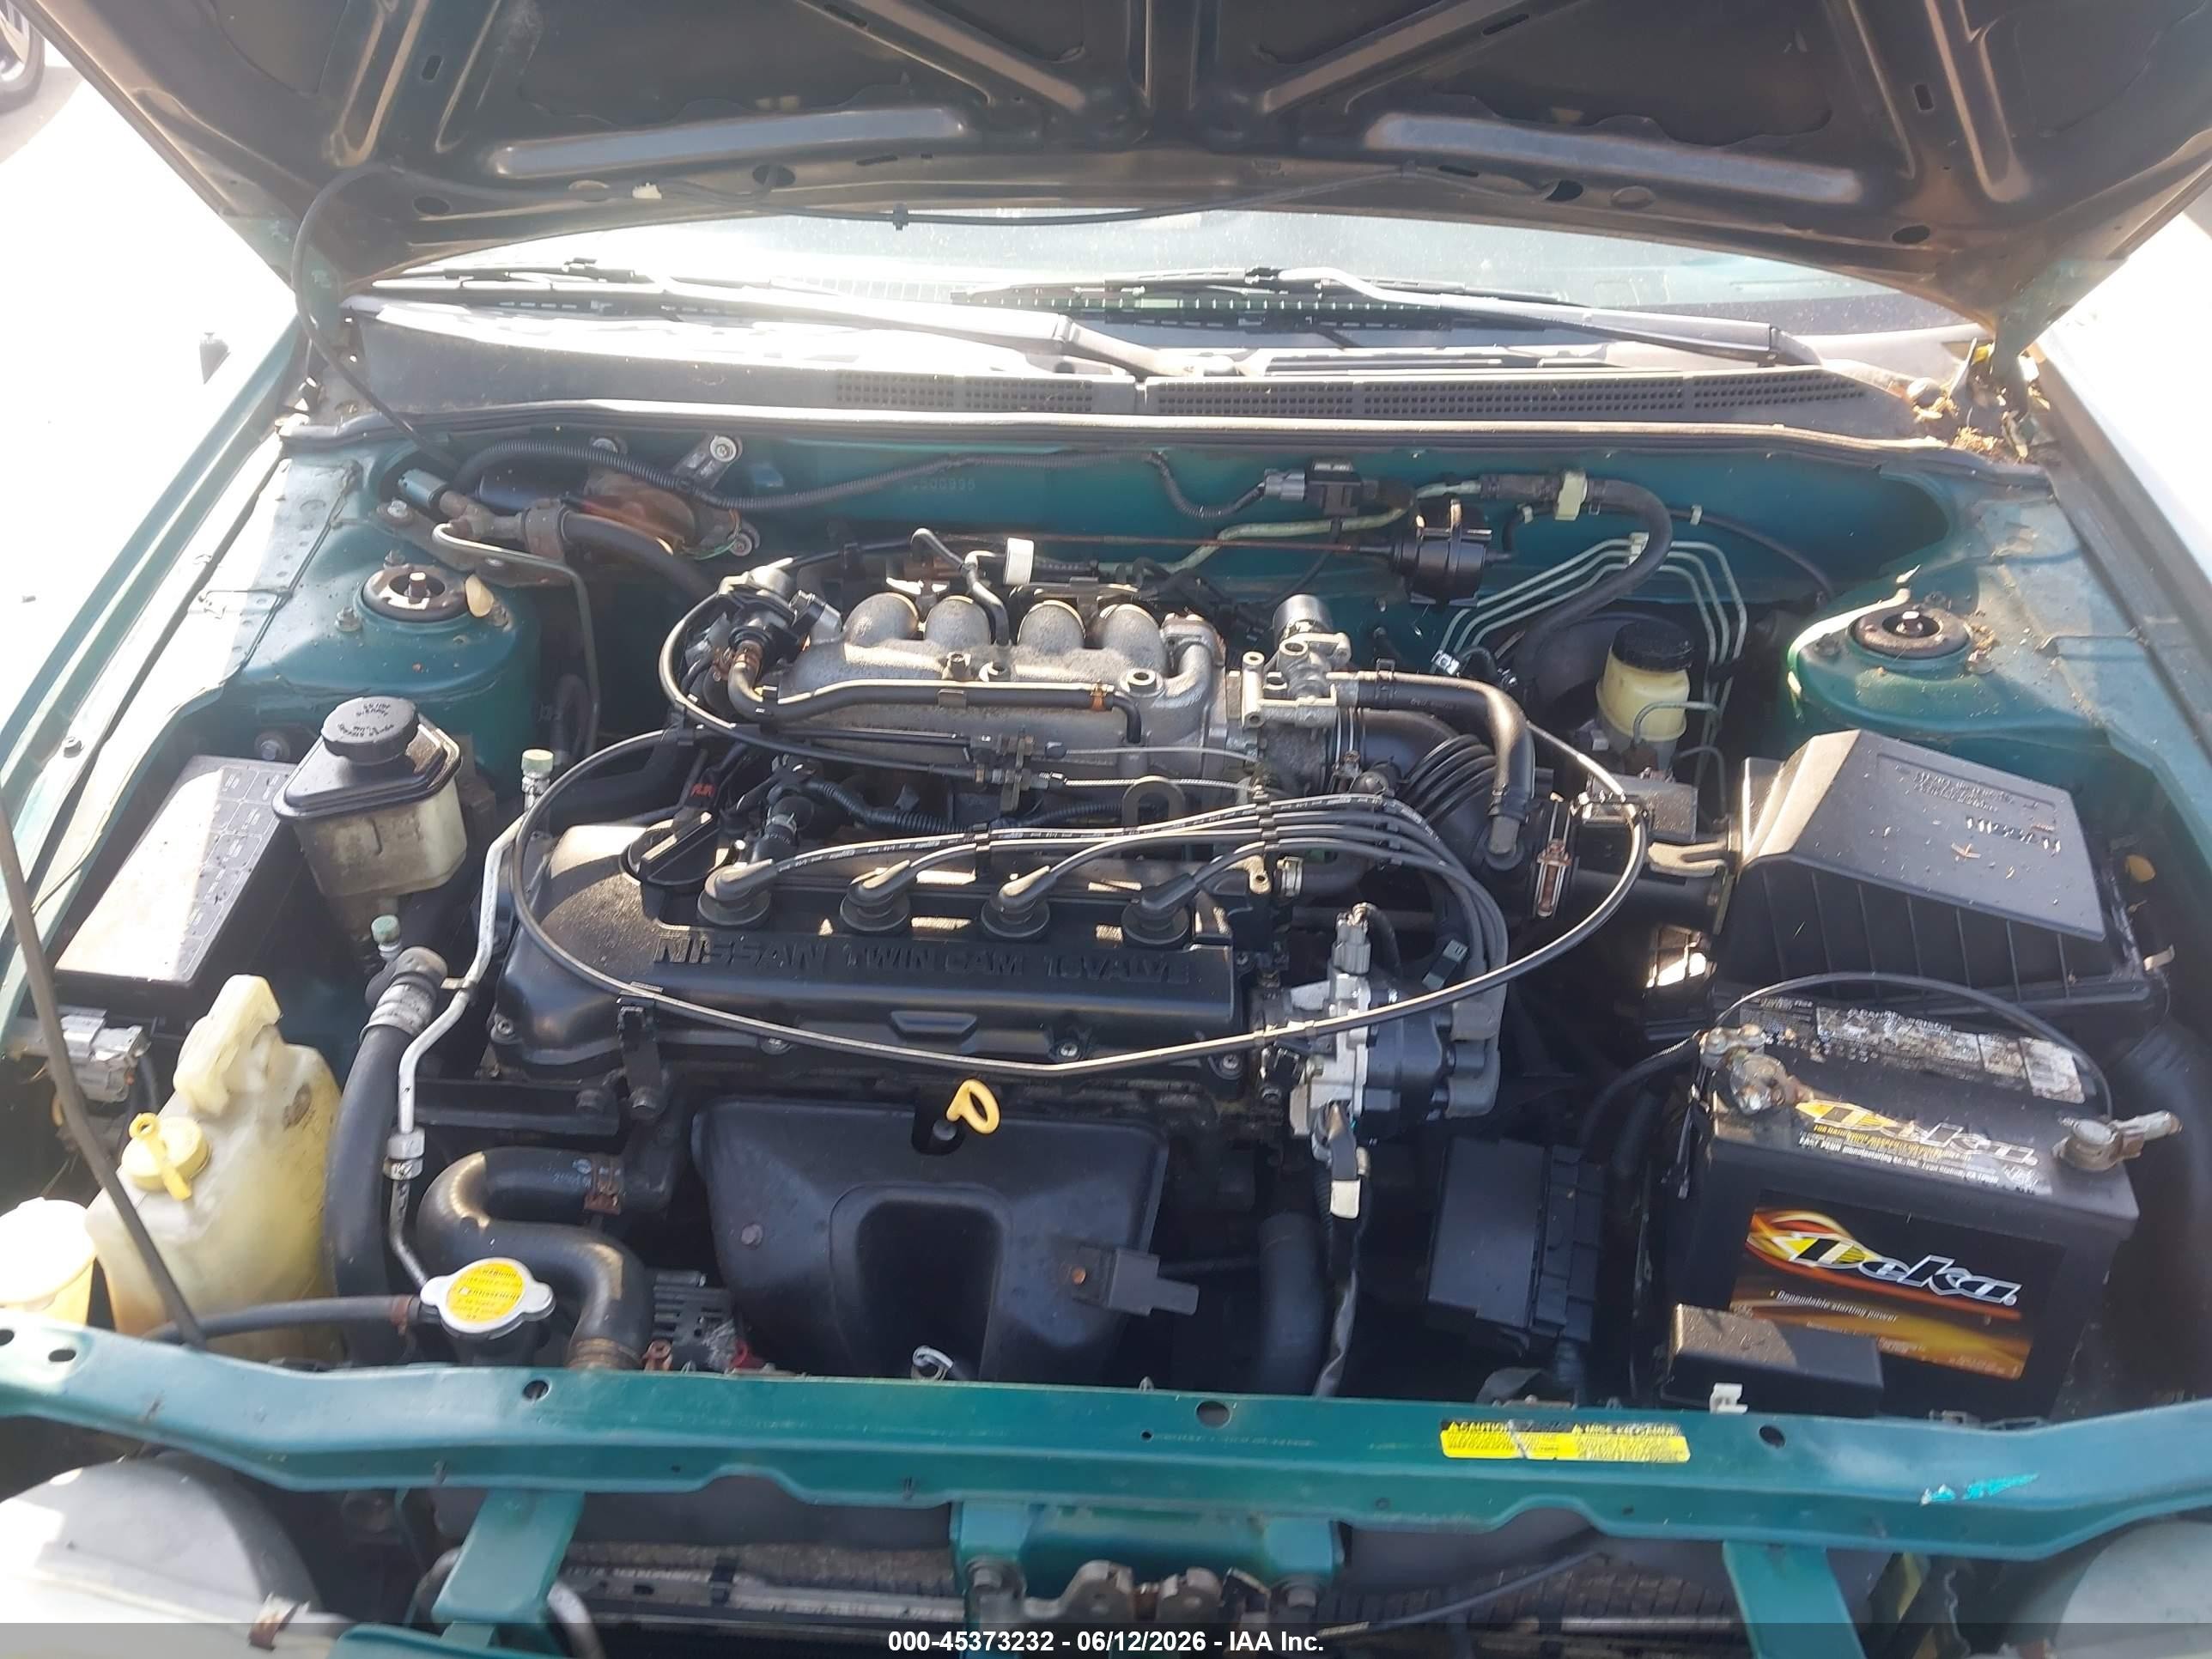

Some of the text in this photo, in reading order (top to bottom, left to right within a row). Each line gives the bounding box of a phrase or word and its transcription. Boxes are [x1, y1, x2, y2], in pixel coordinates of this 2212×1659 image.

[653, 934, 828, 969] NISSAN
[842, 945, 934, 970] TWIN
[945, 949, 1024, 977] CAM
[1772, 1231, 2023, 1304] Deka
[1776, 1290, 1830, 1310] Dependable
[1830, 1302, 1868, 1317] starting
